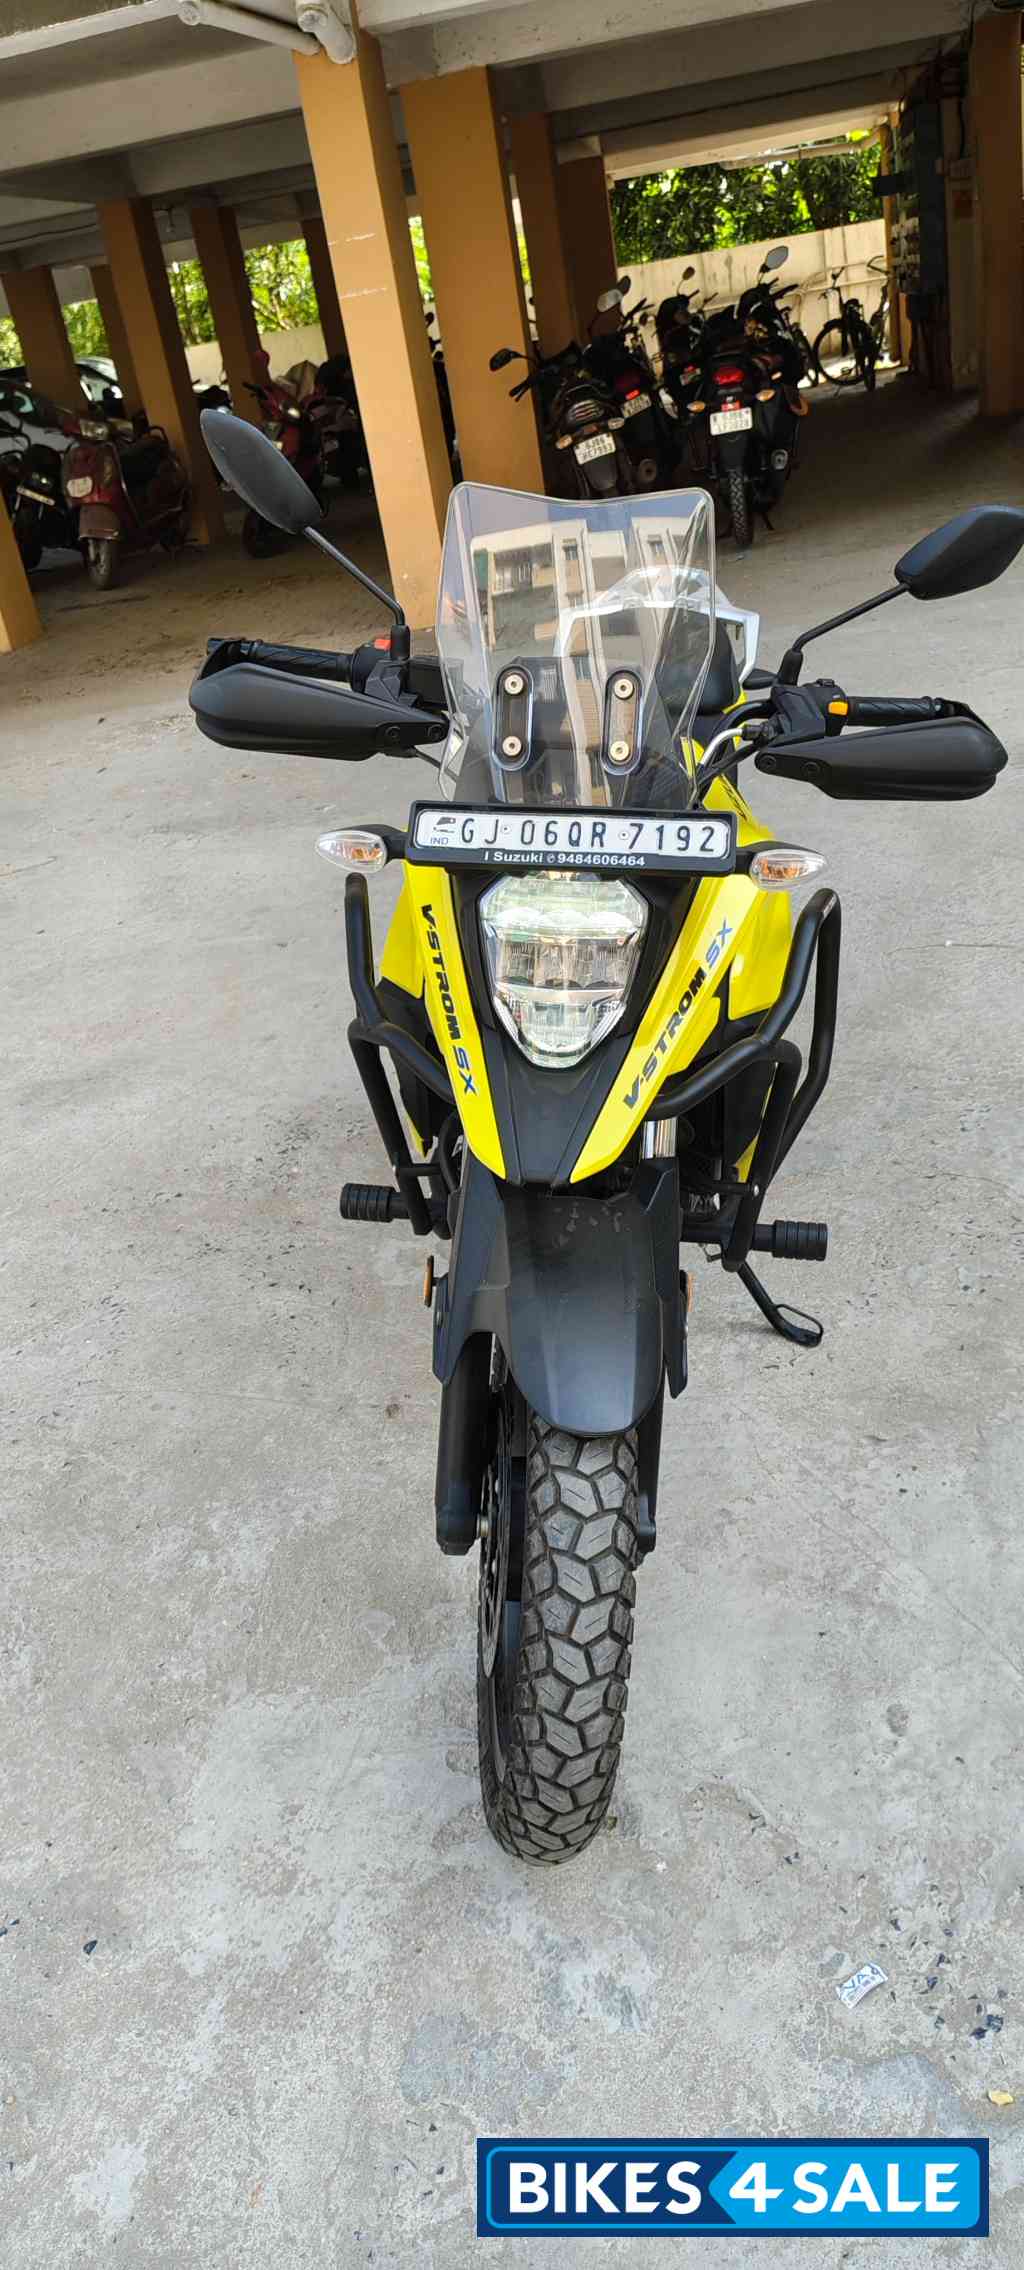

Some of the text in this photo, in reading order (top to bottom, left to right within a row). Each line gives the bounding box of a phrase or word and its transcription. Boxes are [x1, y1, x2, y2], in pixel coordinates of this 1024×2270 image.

[430, 836, 449, 846] IND
[461, 818, 715, 852] GJ 06QR 7192
[493, 851, 543, 863] Suzuki
[557, 853, 646, 867] 9484606464
[420, 903, 479, 1096] V-STROM SX
[623, 918, 733, 1110] V-STROM SX
